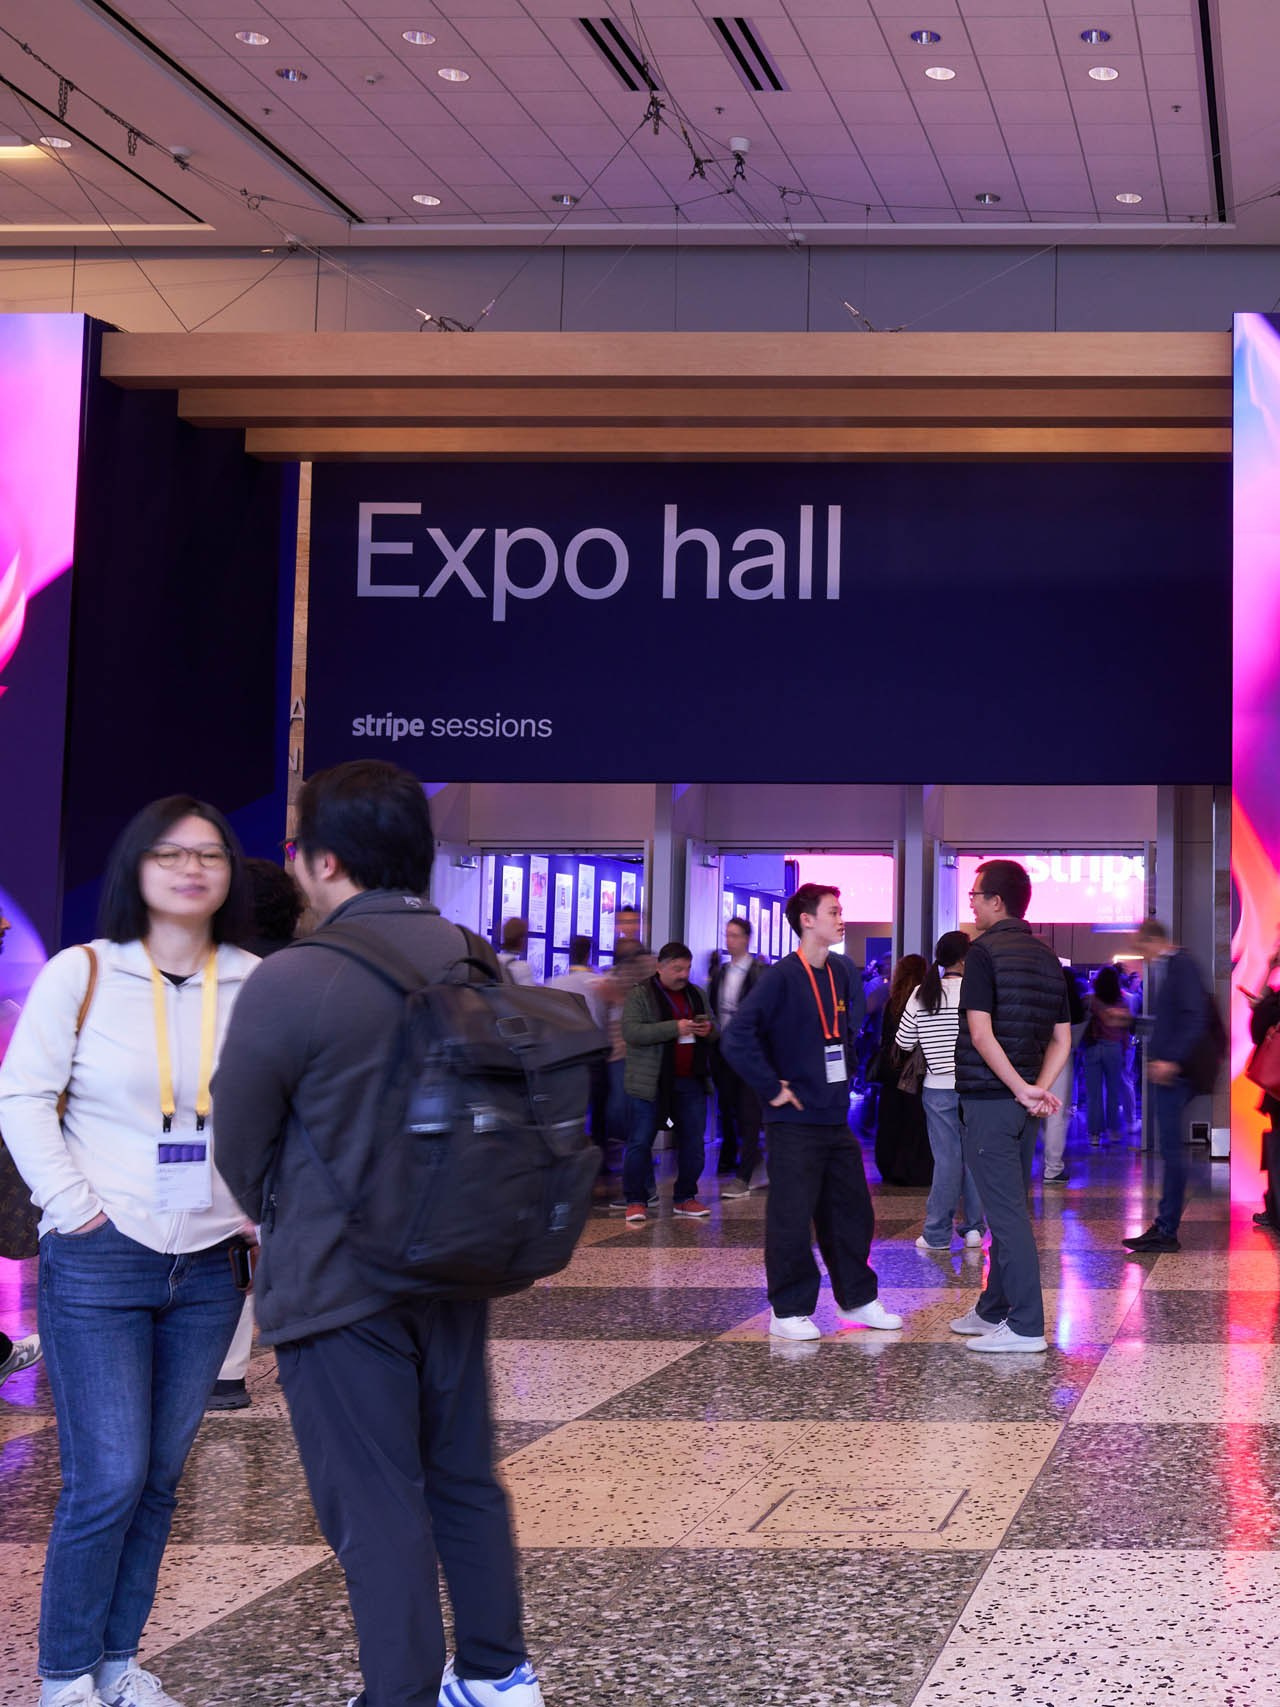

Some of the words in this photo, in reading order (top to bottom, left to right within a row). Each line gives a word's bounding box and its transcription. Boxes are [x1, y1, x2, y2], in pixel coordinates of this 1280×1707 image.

[357, 502, 630, 622] Expo
[662, 503, 842, 601] hall
[352, 712, 425, 742] stripe
[430, 712, 553, 738] sessions
